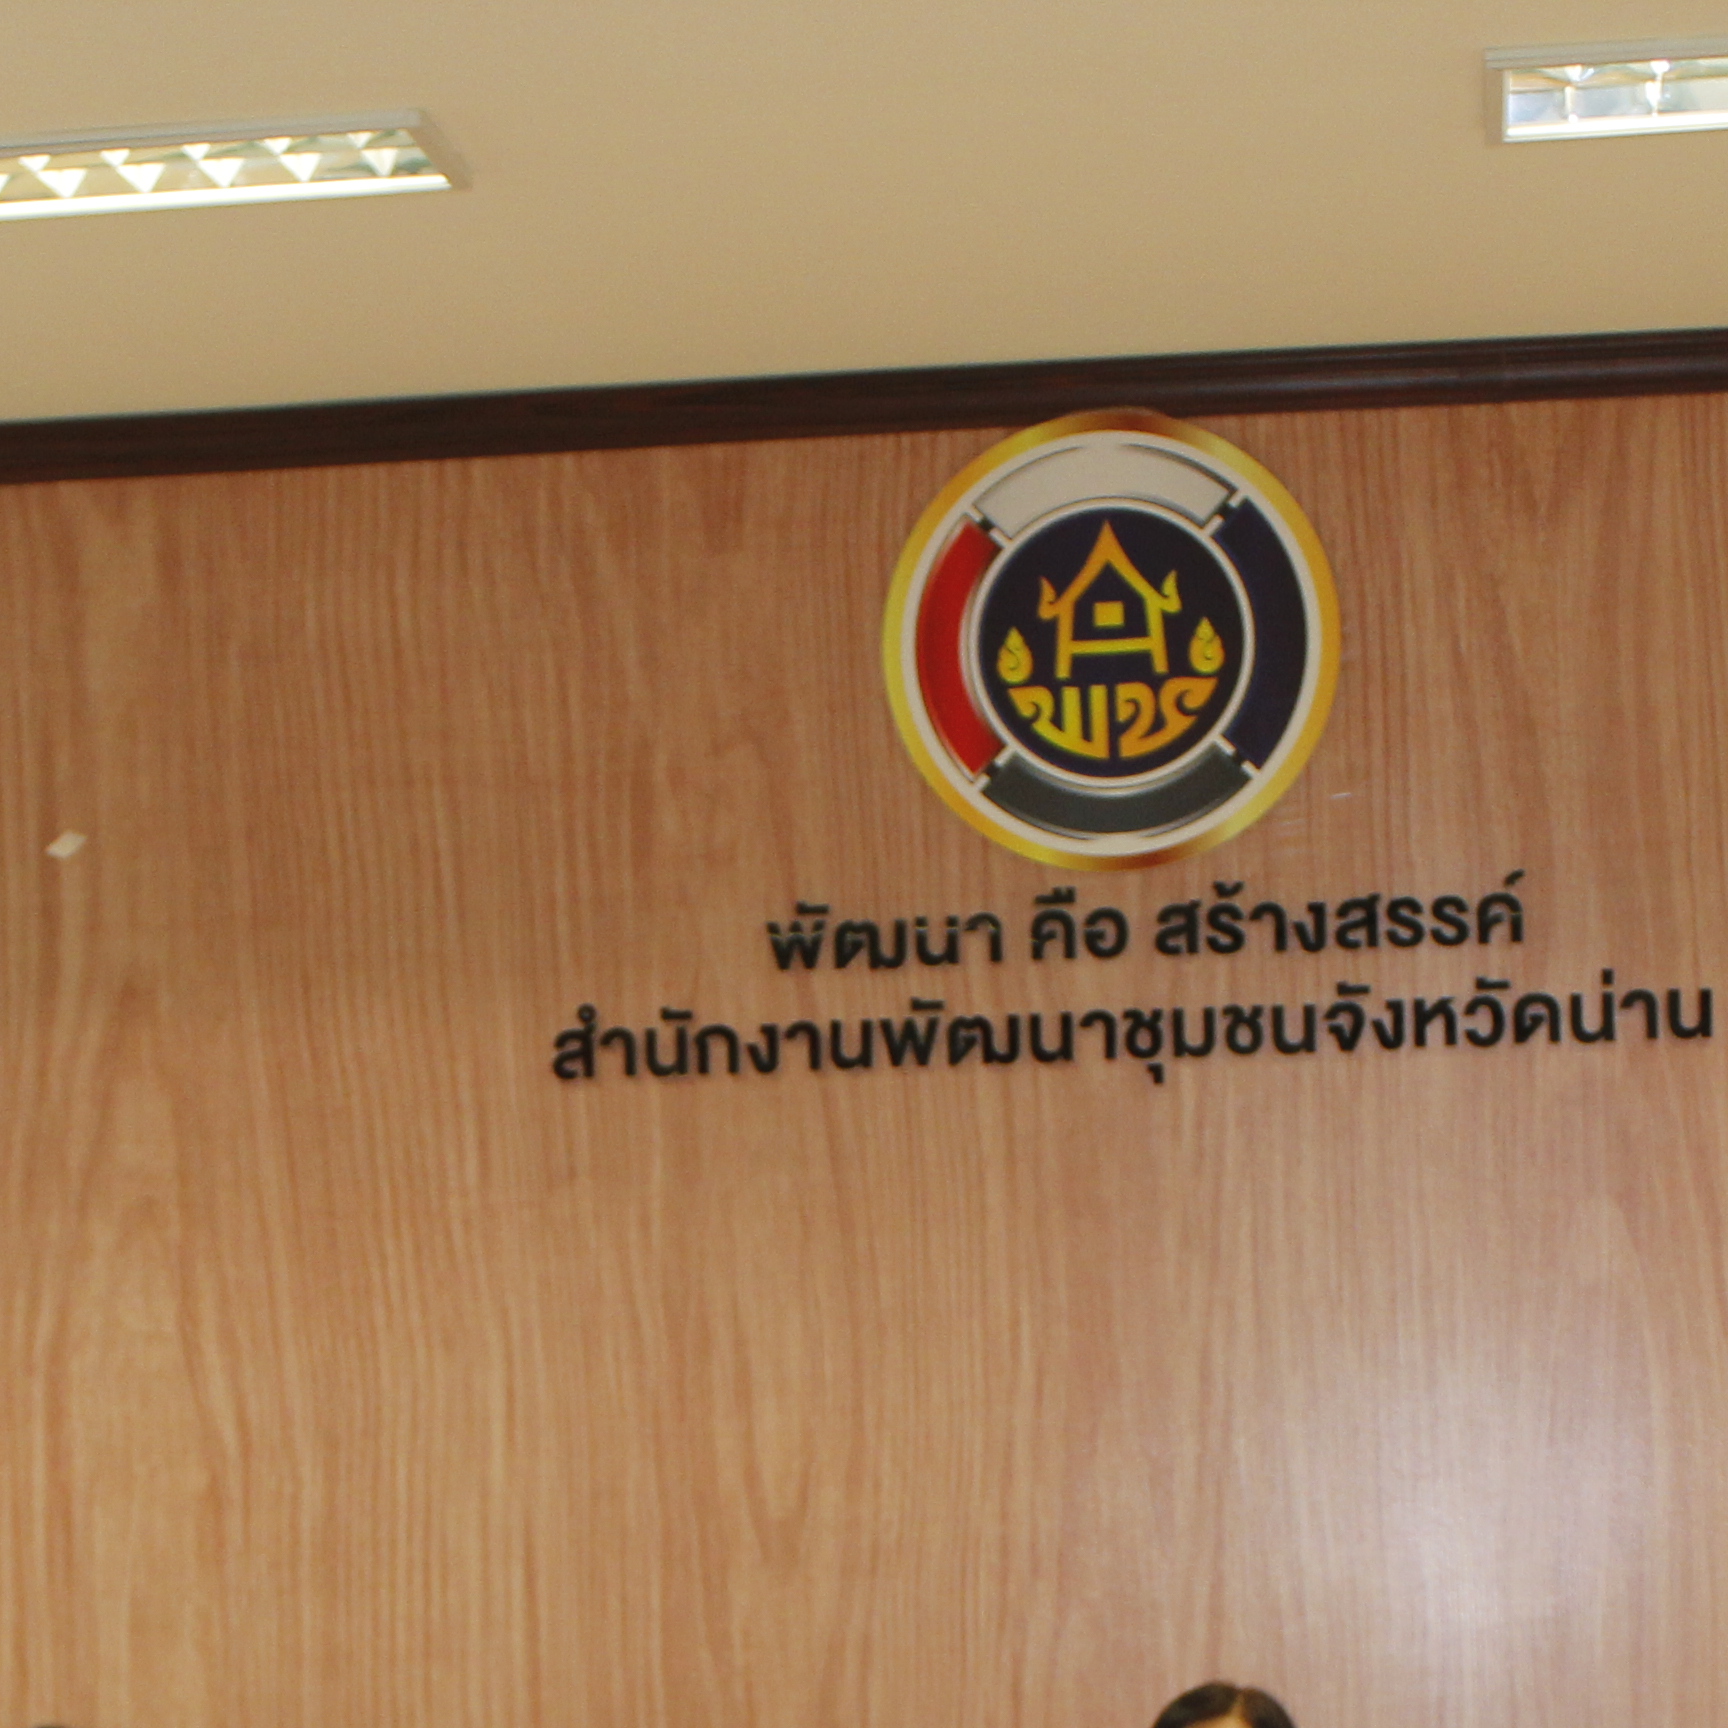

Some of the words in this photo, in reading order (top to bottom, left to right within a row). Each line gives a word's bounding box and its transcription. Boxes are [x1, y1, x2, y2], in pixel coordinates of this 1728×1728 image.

[764, 899, 1005, 974] พัฒนา
[1028, 886, 1130, 964] คือ
[1152, 869, 1526, 959] สร้างสรรค์
[550, 968, 1714, 1086] สำนักงานพัฒนาชุมชนจังหวัดน่าน
